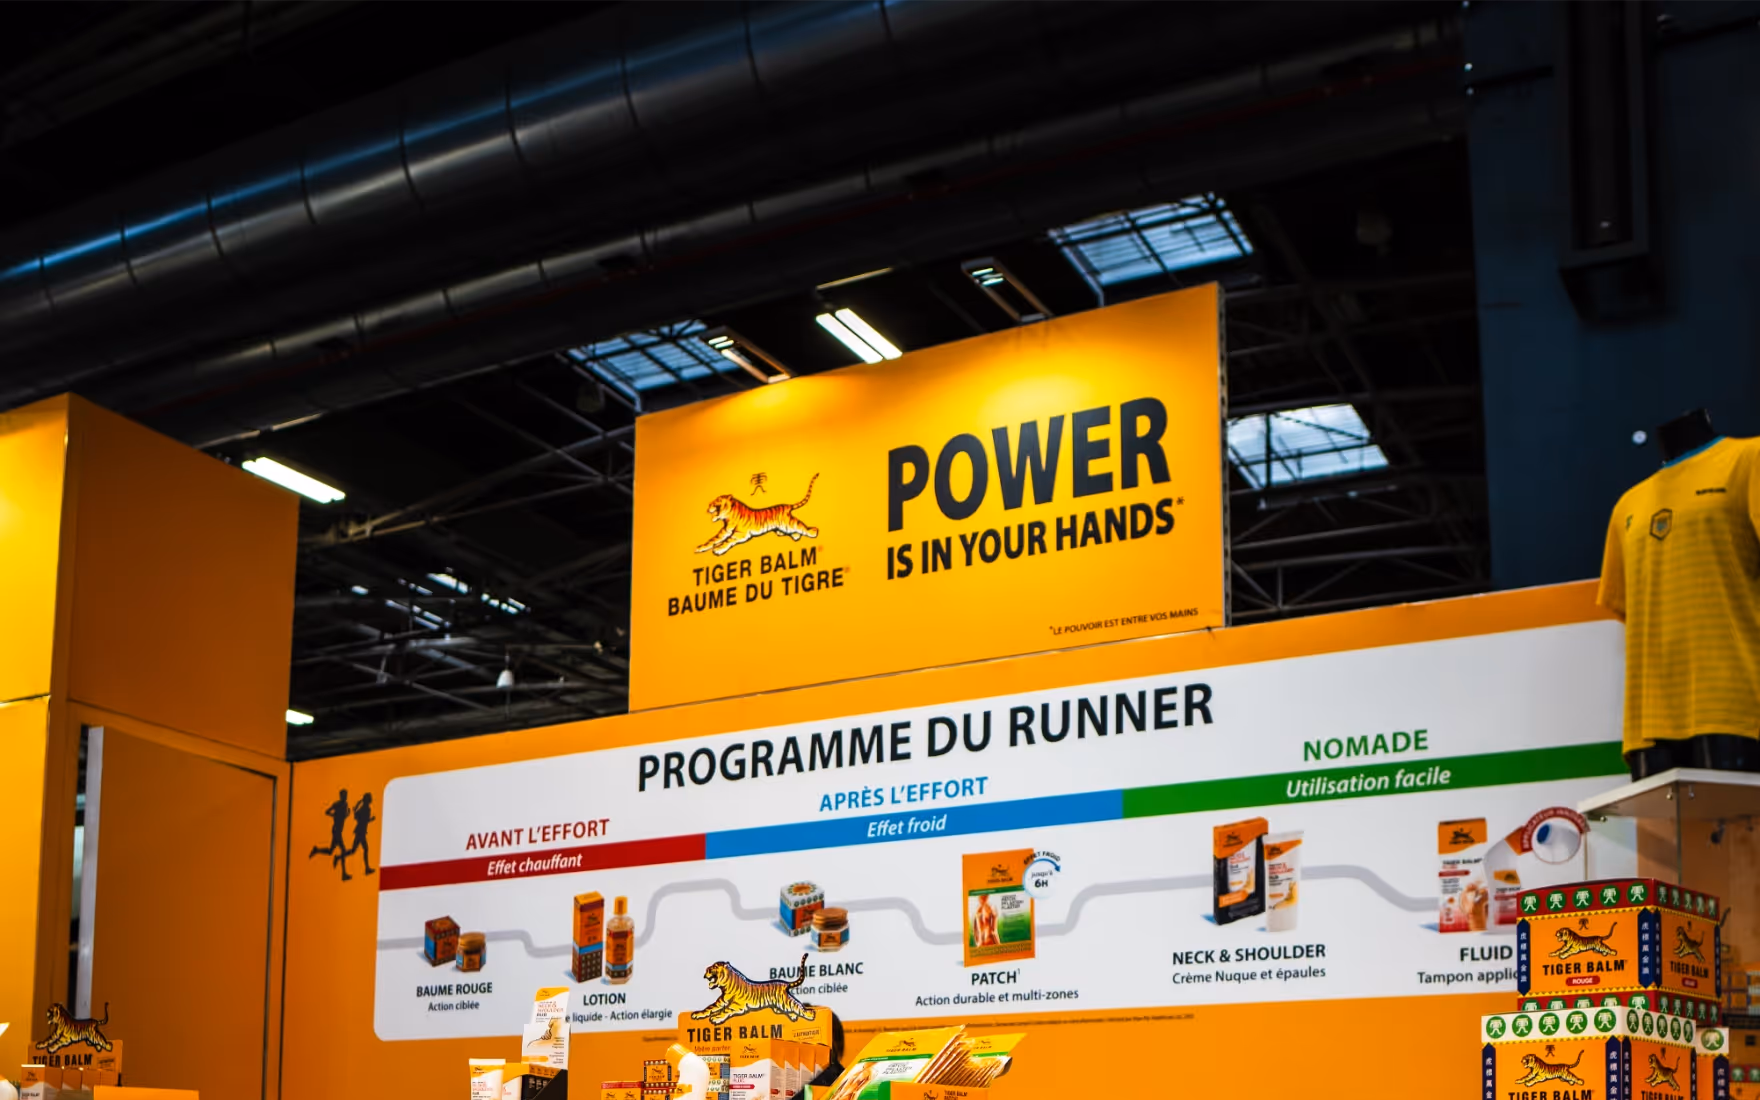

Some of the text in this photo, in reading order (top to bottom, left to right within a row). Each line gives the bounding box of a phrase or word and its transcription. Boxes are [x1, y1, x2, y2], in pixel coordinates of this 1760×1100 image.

[888, 397, 1171, 532] POWER
[887, 542, 913, 580] IS
[921, 537, 952, 574] IN
[962, 520, 1045, 566] YOUR
[693, 559, 752, 587] TIGER
[668, 587, 737, 616] BAUME
[745, 580, 773, 603] DU
[1064, 621, 1103, 633] POUVOIR
[1104, 618, 1119, 628] EST
[1121, 614, 1148, 626] ENTRE
[1149, 612, 1168, 622] VOS
[1169, 607, 1199, 619] MAINS
[638, 683, 1214, 792] PROGRAMME DU RUNNER
[1303, 729, 1428, 762] NOMADE
[1286, 766, 1452, 799] Utilisation facile
[820, 776, 989, 812] APRÈS L’EFFORT
[466, 818, 610, 850] AVANT L’EFFORT
[867, 814, 948, 838] Effet froid
[487, 853, 583, 876] Effet chauffant
[1034, 878, 1049, 888] 6H
[1172, 943, 1327, 966] NECK & SHOULDER
[1459, 944, 1514, 962] FLUID
[818, 962, 864, 977] BLANC
[1172, 964, 1327, 986] Crème Nuque et épaules
[1417, 967, 1518, 988] Tampon applic
[1542, 959, 1626, 976] TIGER BALM
[1670, 960, 1690, 975] TIGER
[417, 982, 493, 998] BAUME ROUGE
[787, 981, 848, 995] ction ciblée
[1572, 976, 1594, 985] ROUGE
[428, 1000, 480, 1012] Action ciblée
[583, 993, 627, 1007] LOTION
[915, 988, 1079, 1007] Action durable et multi-zones
[572, 1010, 603, 1024] liquide
[610, 1010, 638, 1021] Action
[640, 1008, 673, 1022] élargie
[687, 1027, 733, 1043] TIGER
[739, 1024, 784, 1039] BALM
[32, 1055, 61, 1066] TIGER
[64, 1054, 93, 1066] BALM
